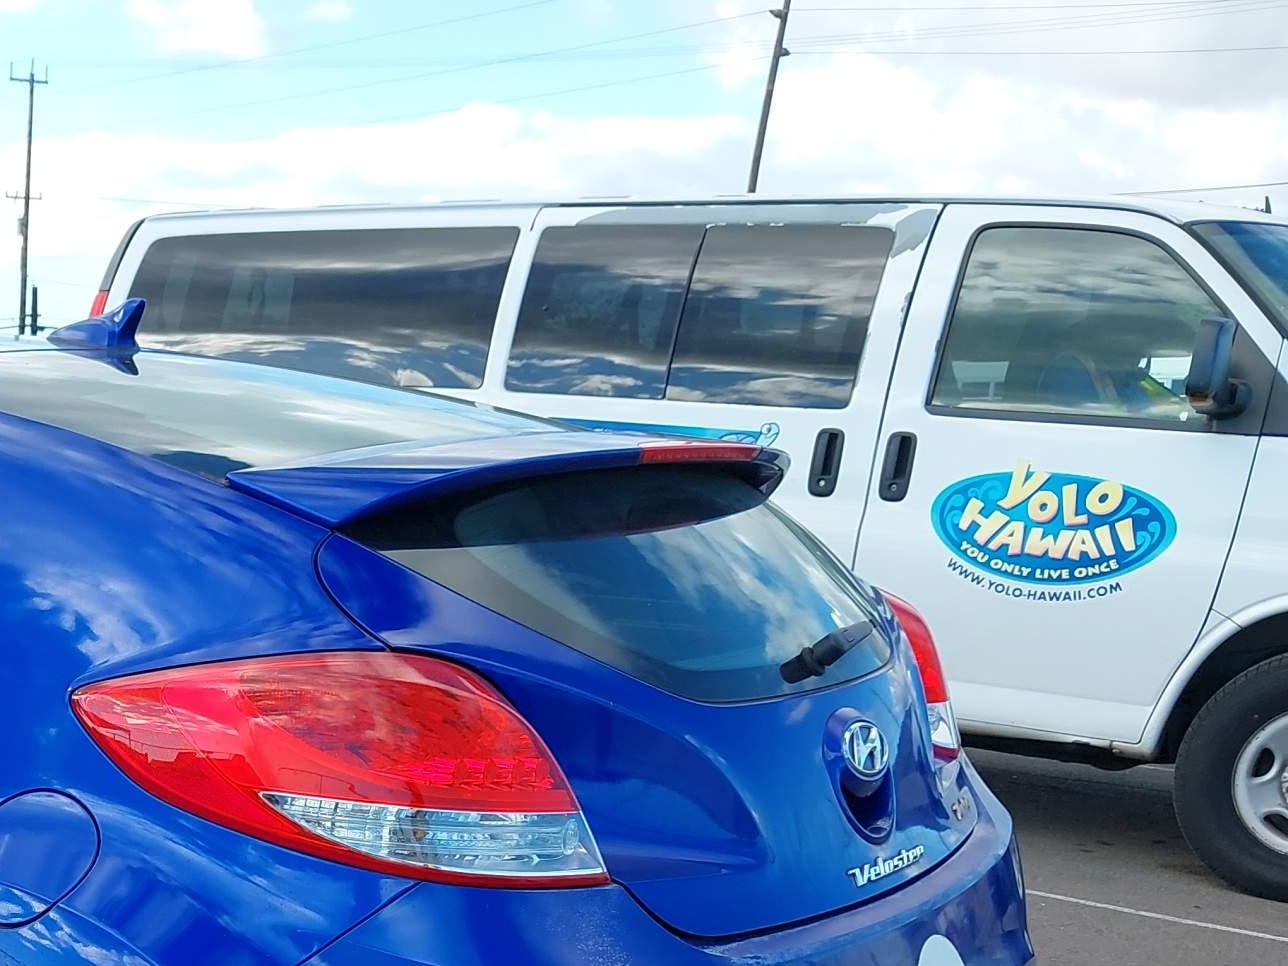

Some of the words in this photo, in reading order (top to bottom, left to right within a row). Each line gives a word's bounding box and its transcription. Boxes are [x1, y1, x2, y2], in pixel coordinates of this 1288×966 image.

[998, 459, 1124, 526] YOLO
[959, 498, 1136, 561] HAWAII
[946, 557, 1123, 602] WWW.YOLO-HAWAII.COM
[960, 541, 989, 564] YOU
[990, 558, 1030, 577] ONLY
[1035, 567, 1069, 580] LIVE
[1074, 558, 1120, 578] ONCE
[847, 844, 925, 887] Veloster
